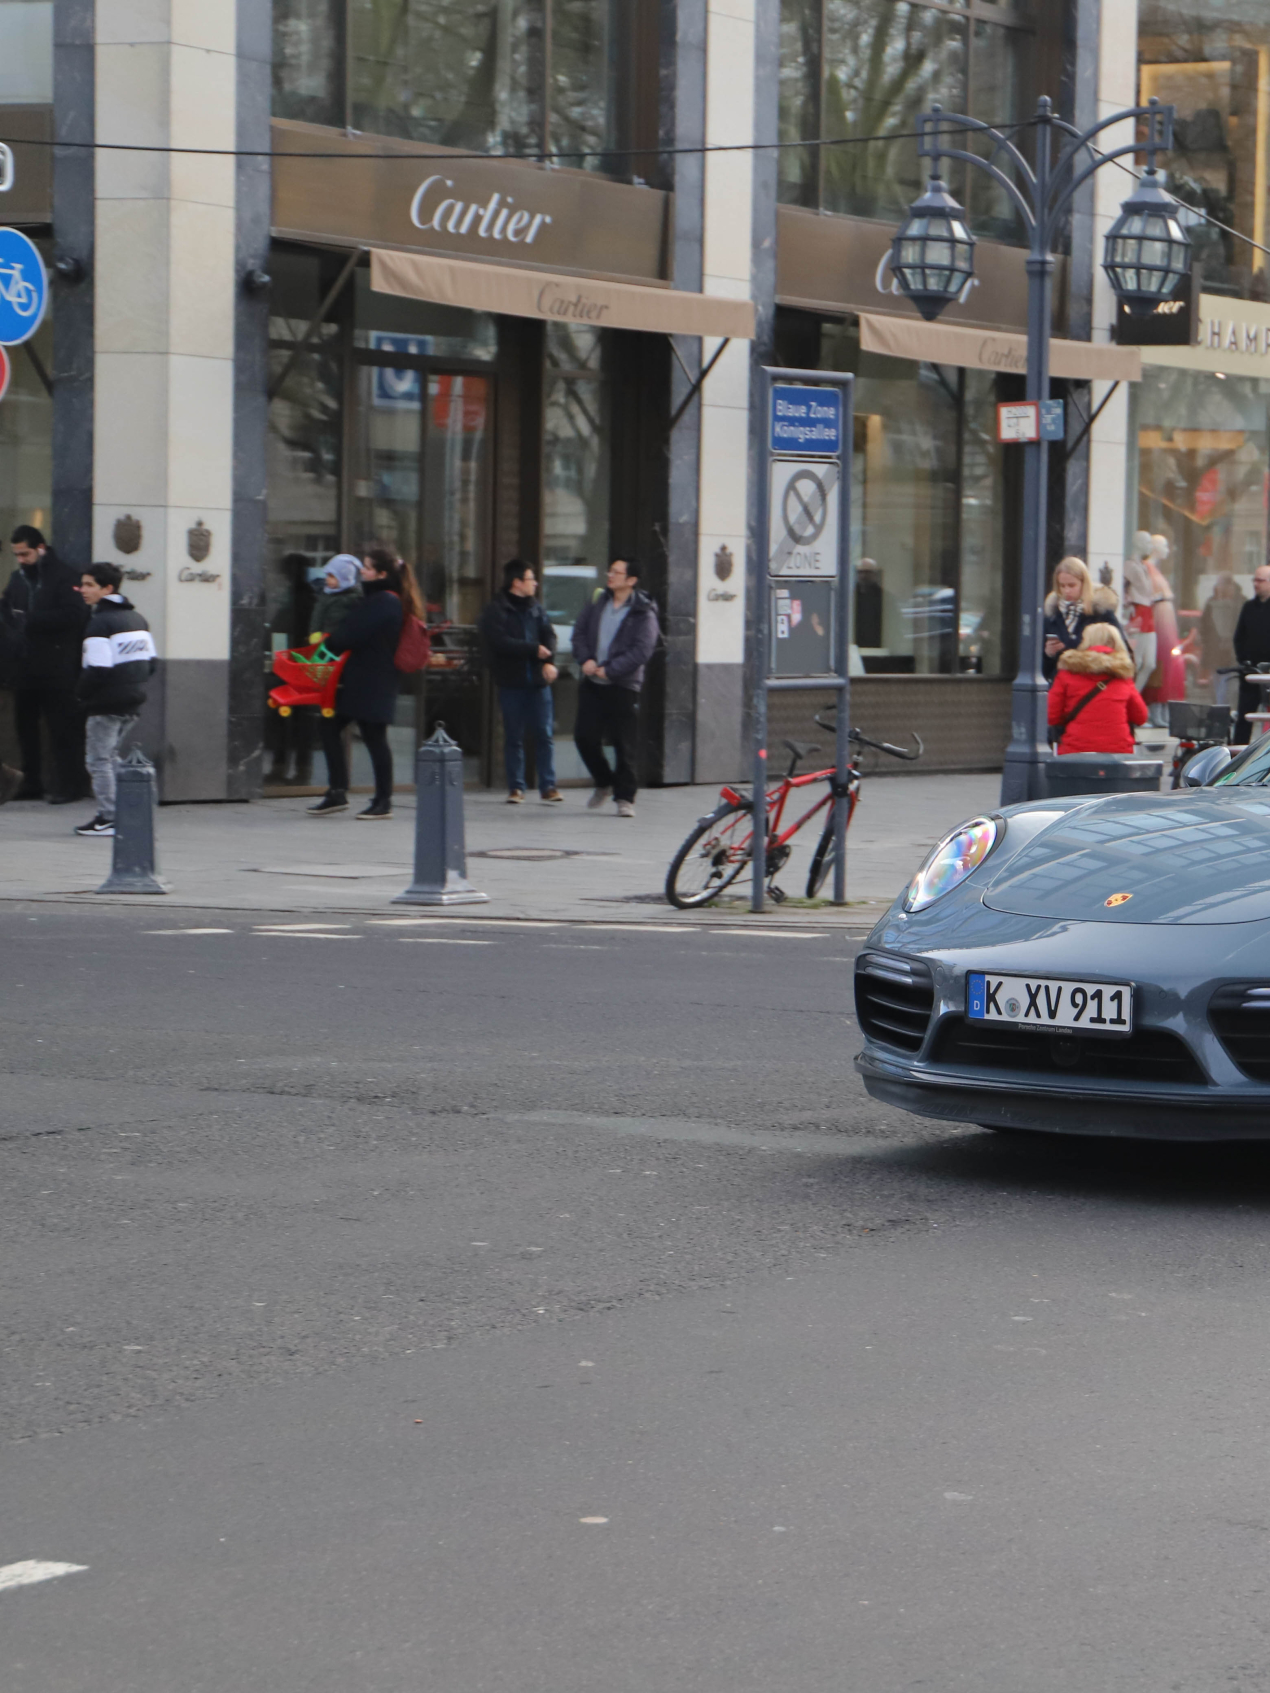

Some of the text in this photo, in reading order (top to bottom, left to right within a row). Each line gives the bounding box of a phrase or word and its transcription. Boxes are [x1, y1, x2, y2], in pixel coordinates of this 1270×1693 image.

[410, 175, 552, 243] Cartier
[537, 282, 609, 320] Cartier
[776, 400, 836, 419] Blaue Zone
[774, 422, 837, 442] Königsallee
[786, 551, 822, 570] ZONE
[178, 567, 221, 583] Cartier
[973, 980, 1127, 1025] D K XV 911
